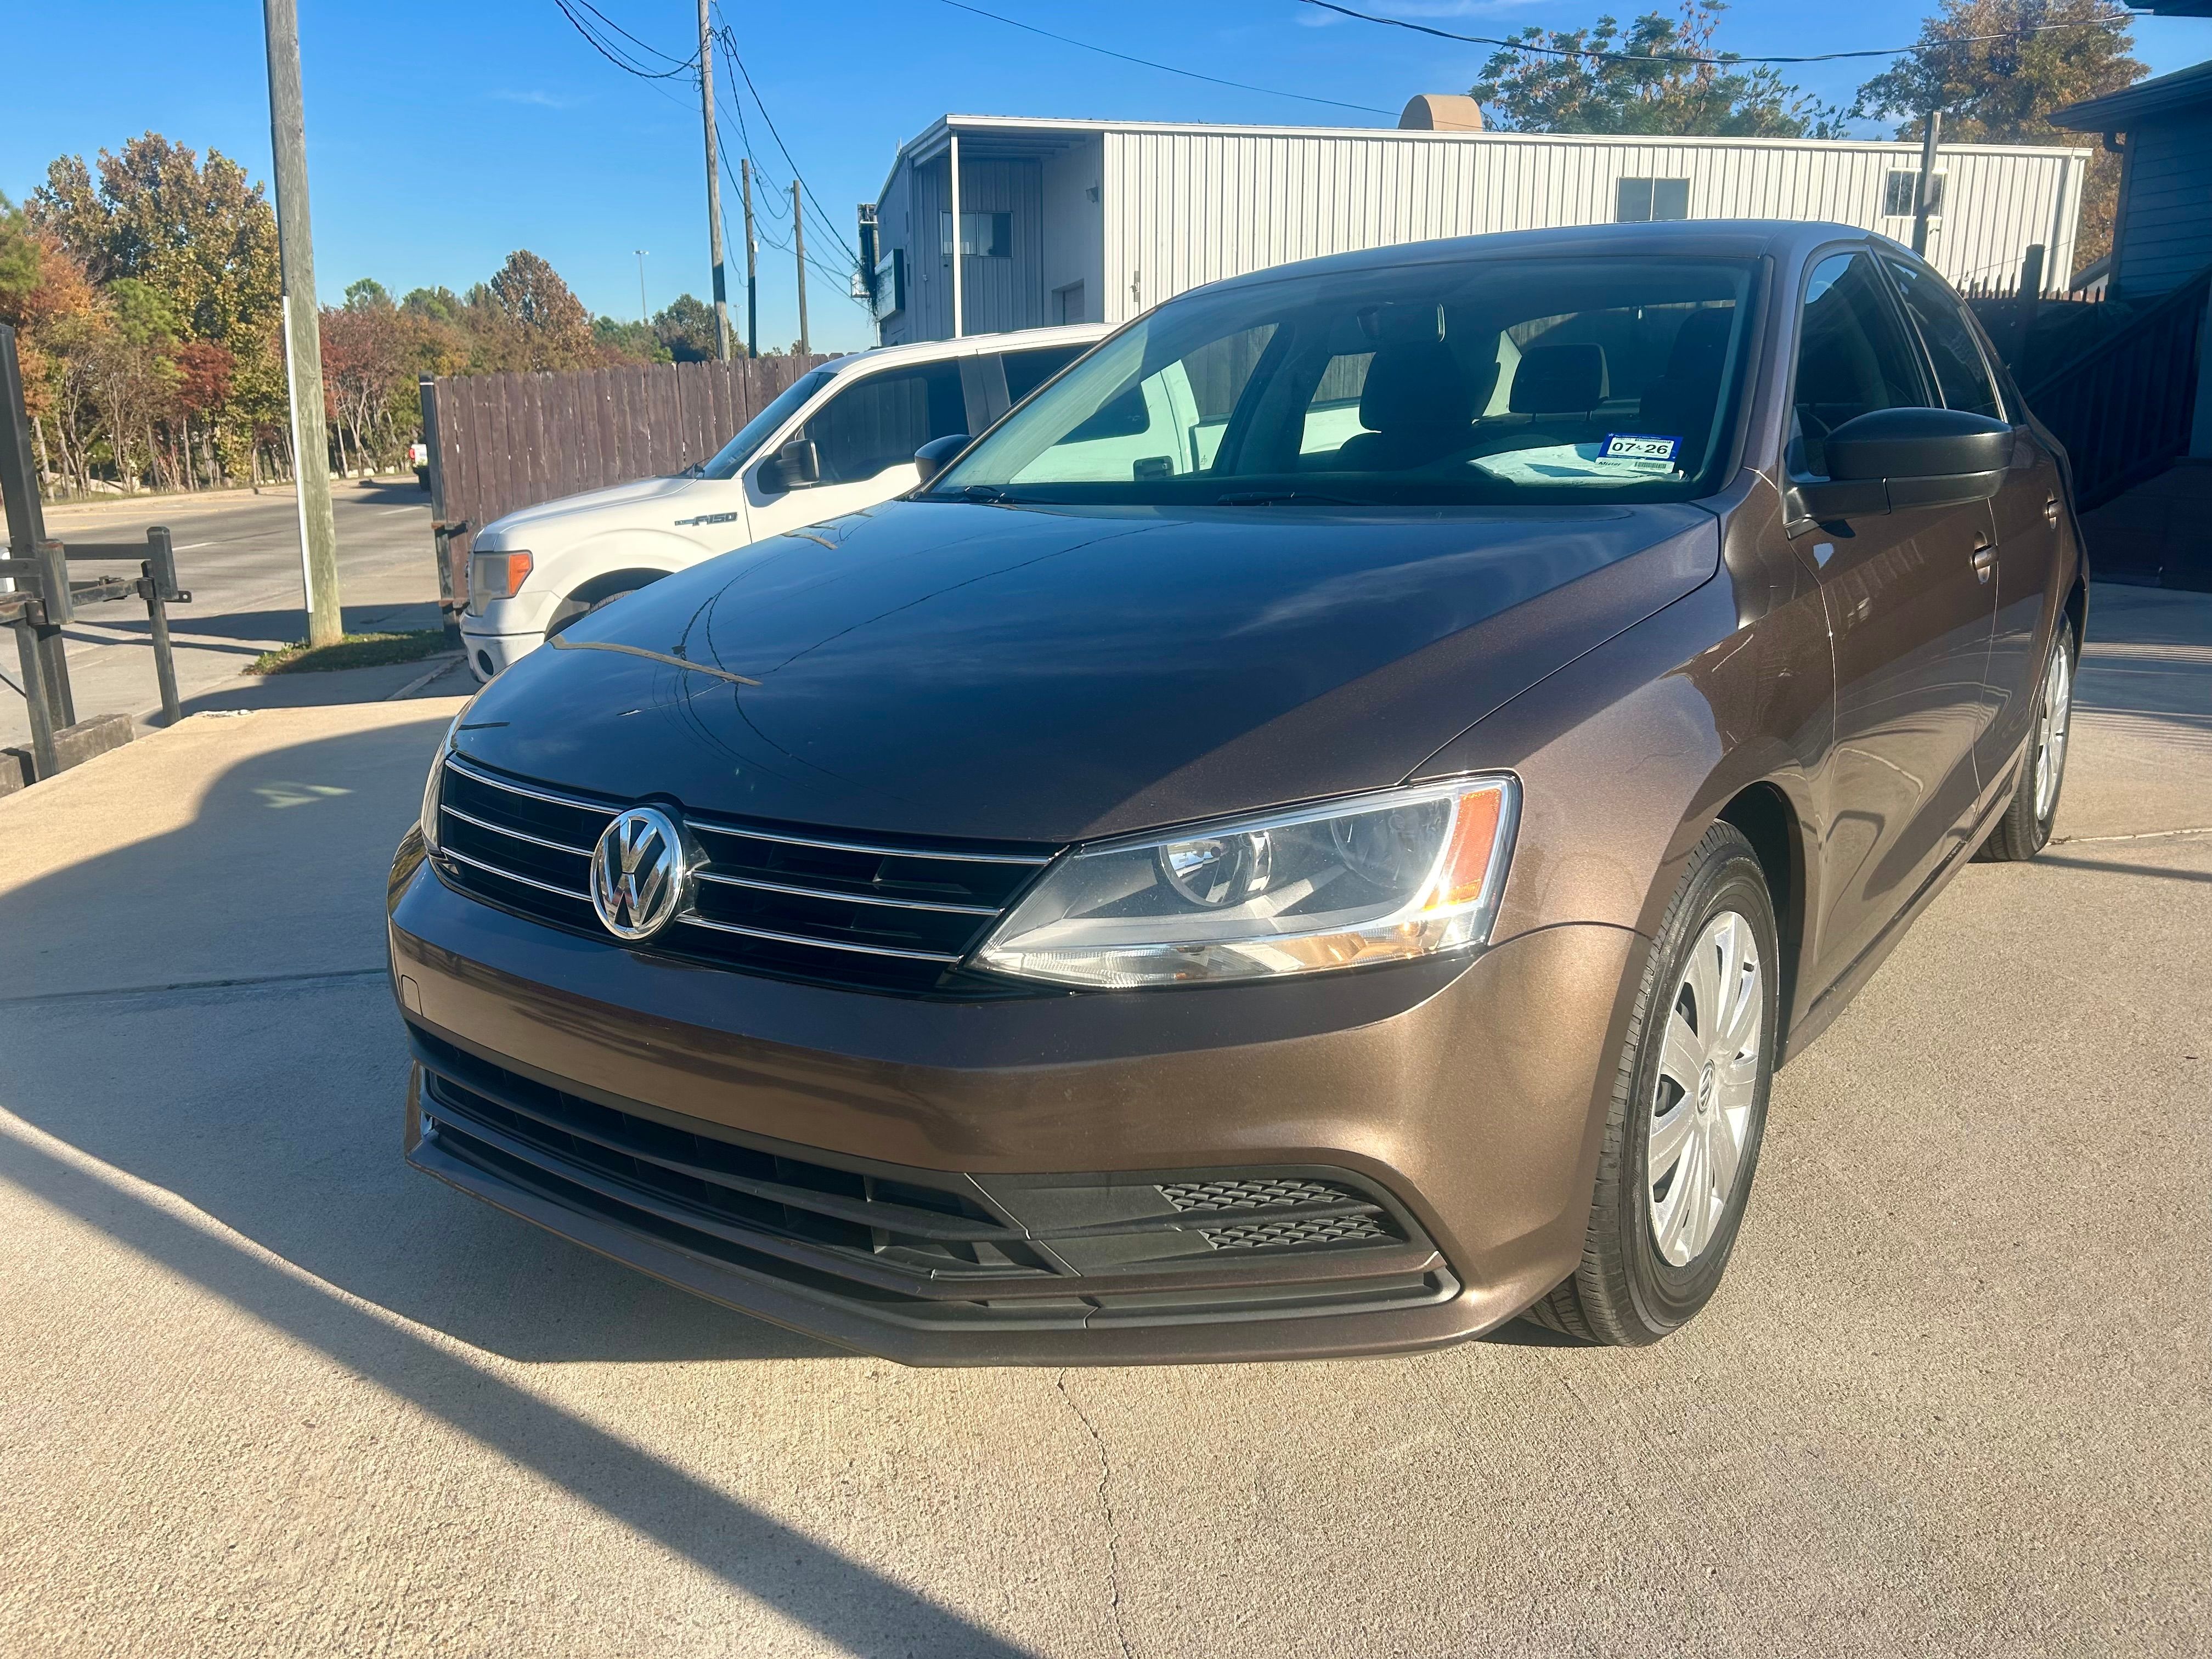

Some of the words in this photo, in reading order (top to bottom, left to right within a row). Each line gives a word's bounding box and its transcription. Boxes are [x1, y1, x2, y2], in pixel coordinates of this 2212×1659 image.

[1612, 442, 1636, 452] 07
[1644, 444, 1668, 454] 26
[595, 811, 679, 935] VW
